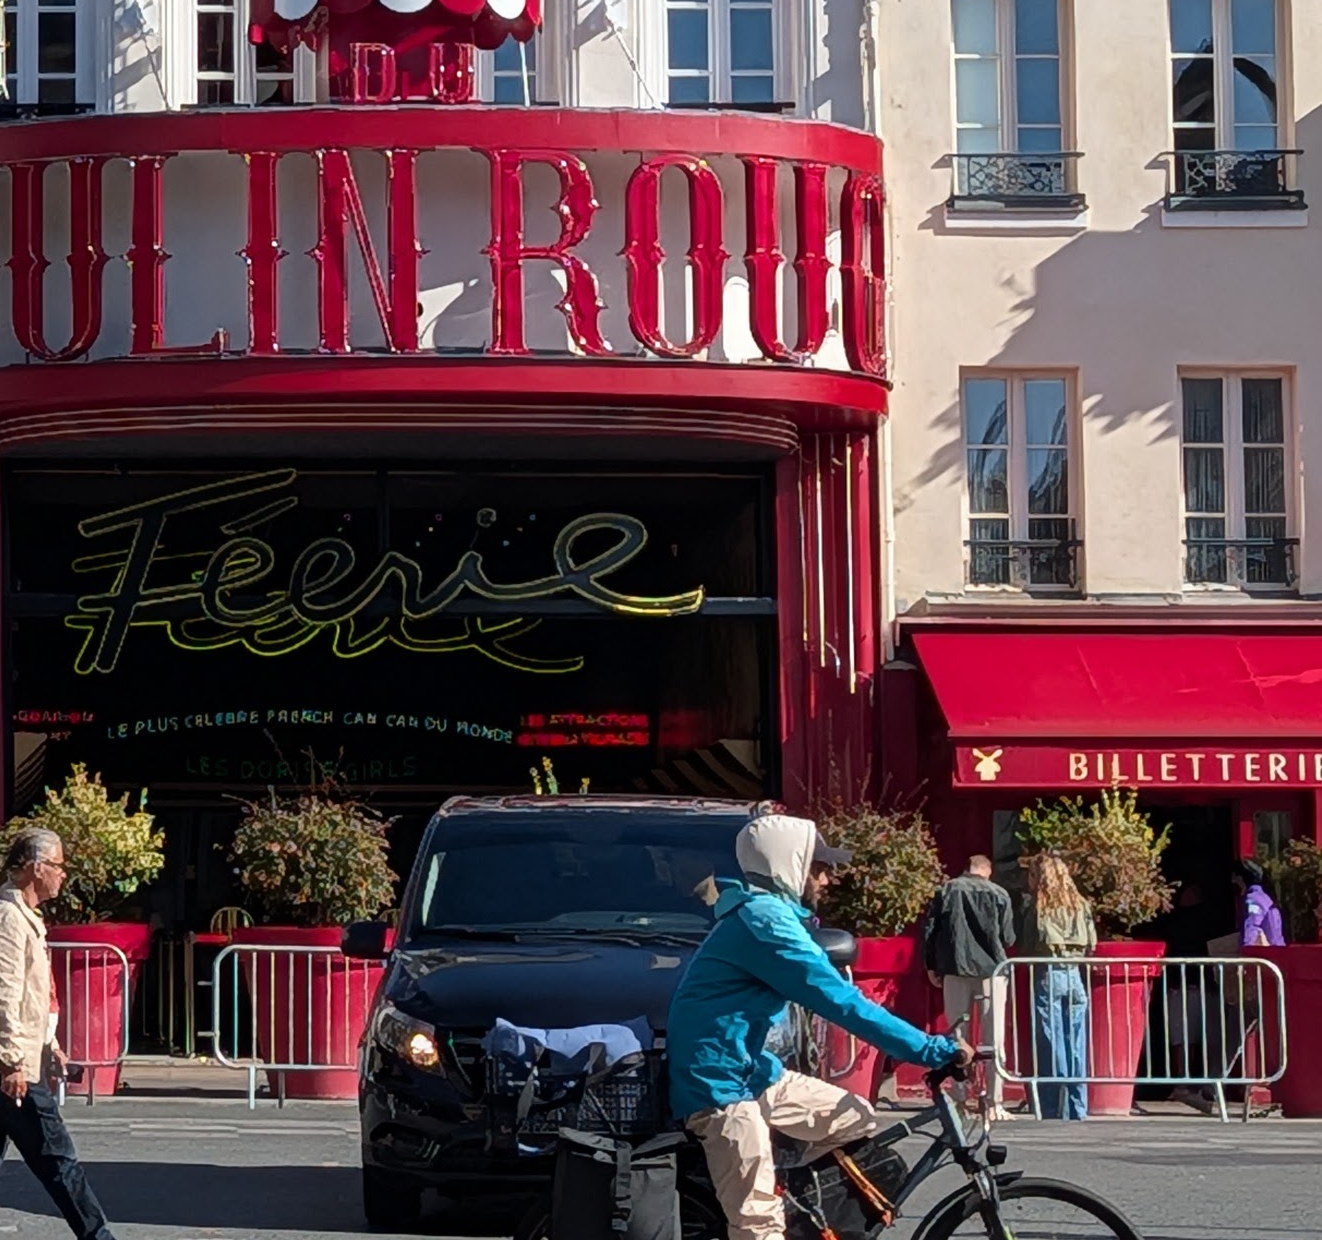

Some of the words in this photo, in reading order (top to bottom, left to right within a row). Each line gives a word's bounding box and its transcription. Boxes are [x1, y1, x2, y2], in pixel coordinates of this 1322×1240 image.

[134, 715, 179, 735] PLUS
[343, 711, 377, 726] CAN
[386, 713, 419, 728] CAN
[424, 715, 448, 733] DU
